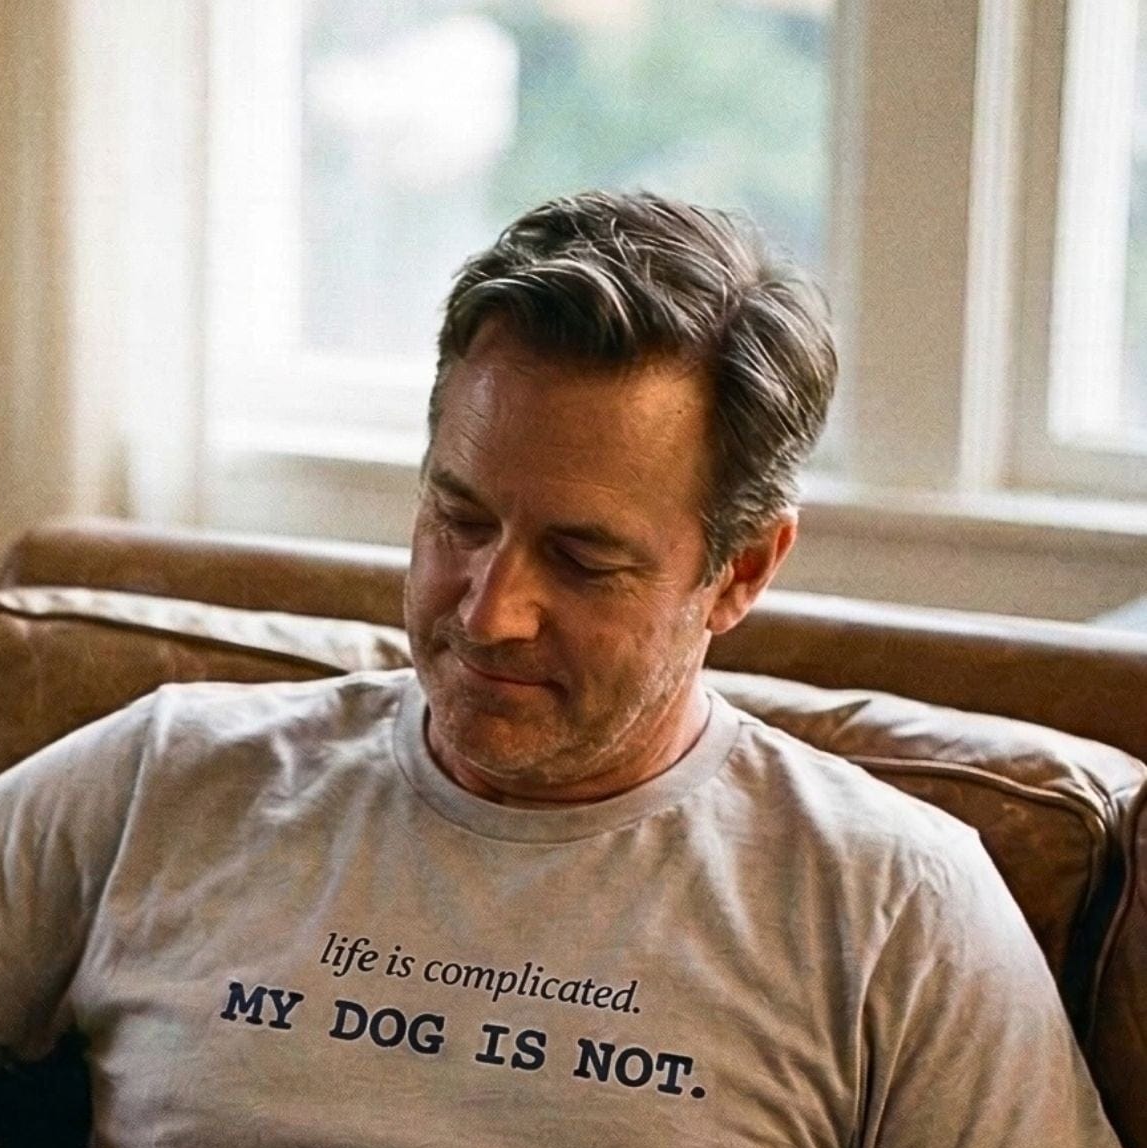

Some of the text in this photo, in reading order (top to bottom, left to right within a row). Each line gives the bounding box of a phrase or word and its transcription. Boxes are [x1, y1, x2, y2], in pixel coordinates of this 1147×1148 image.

[320, 932, 641, 1014] life is complicated.
[220, 982, 706, 1100] MY DOG IS NOT.
